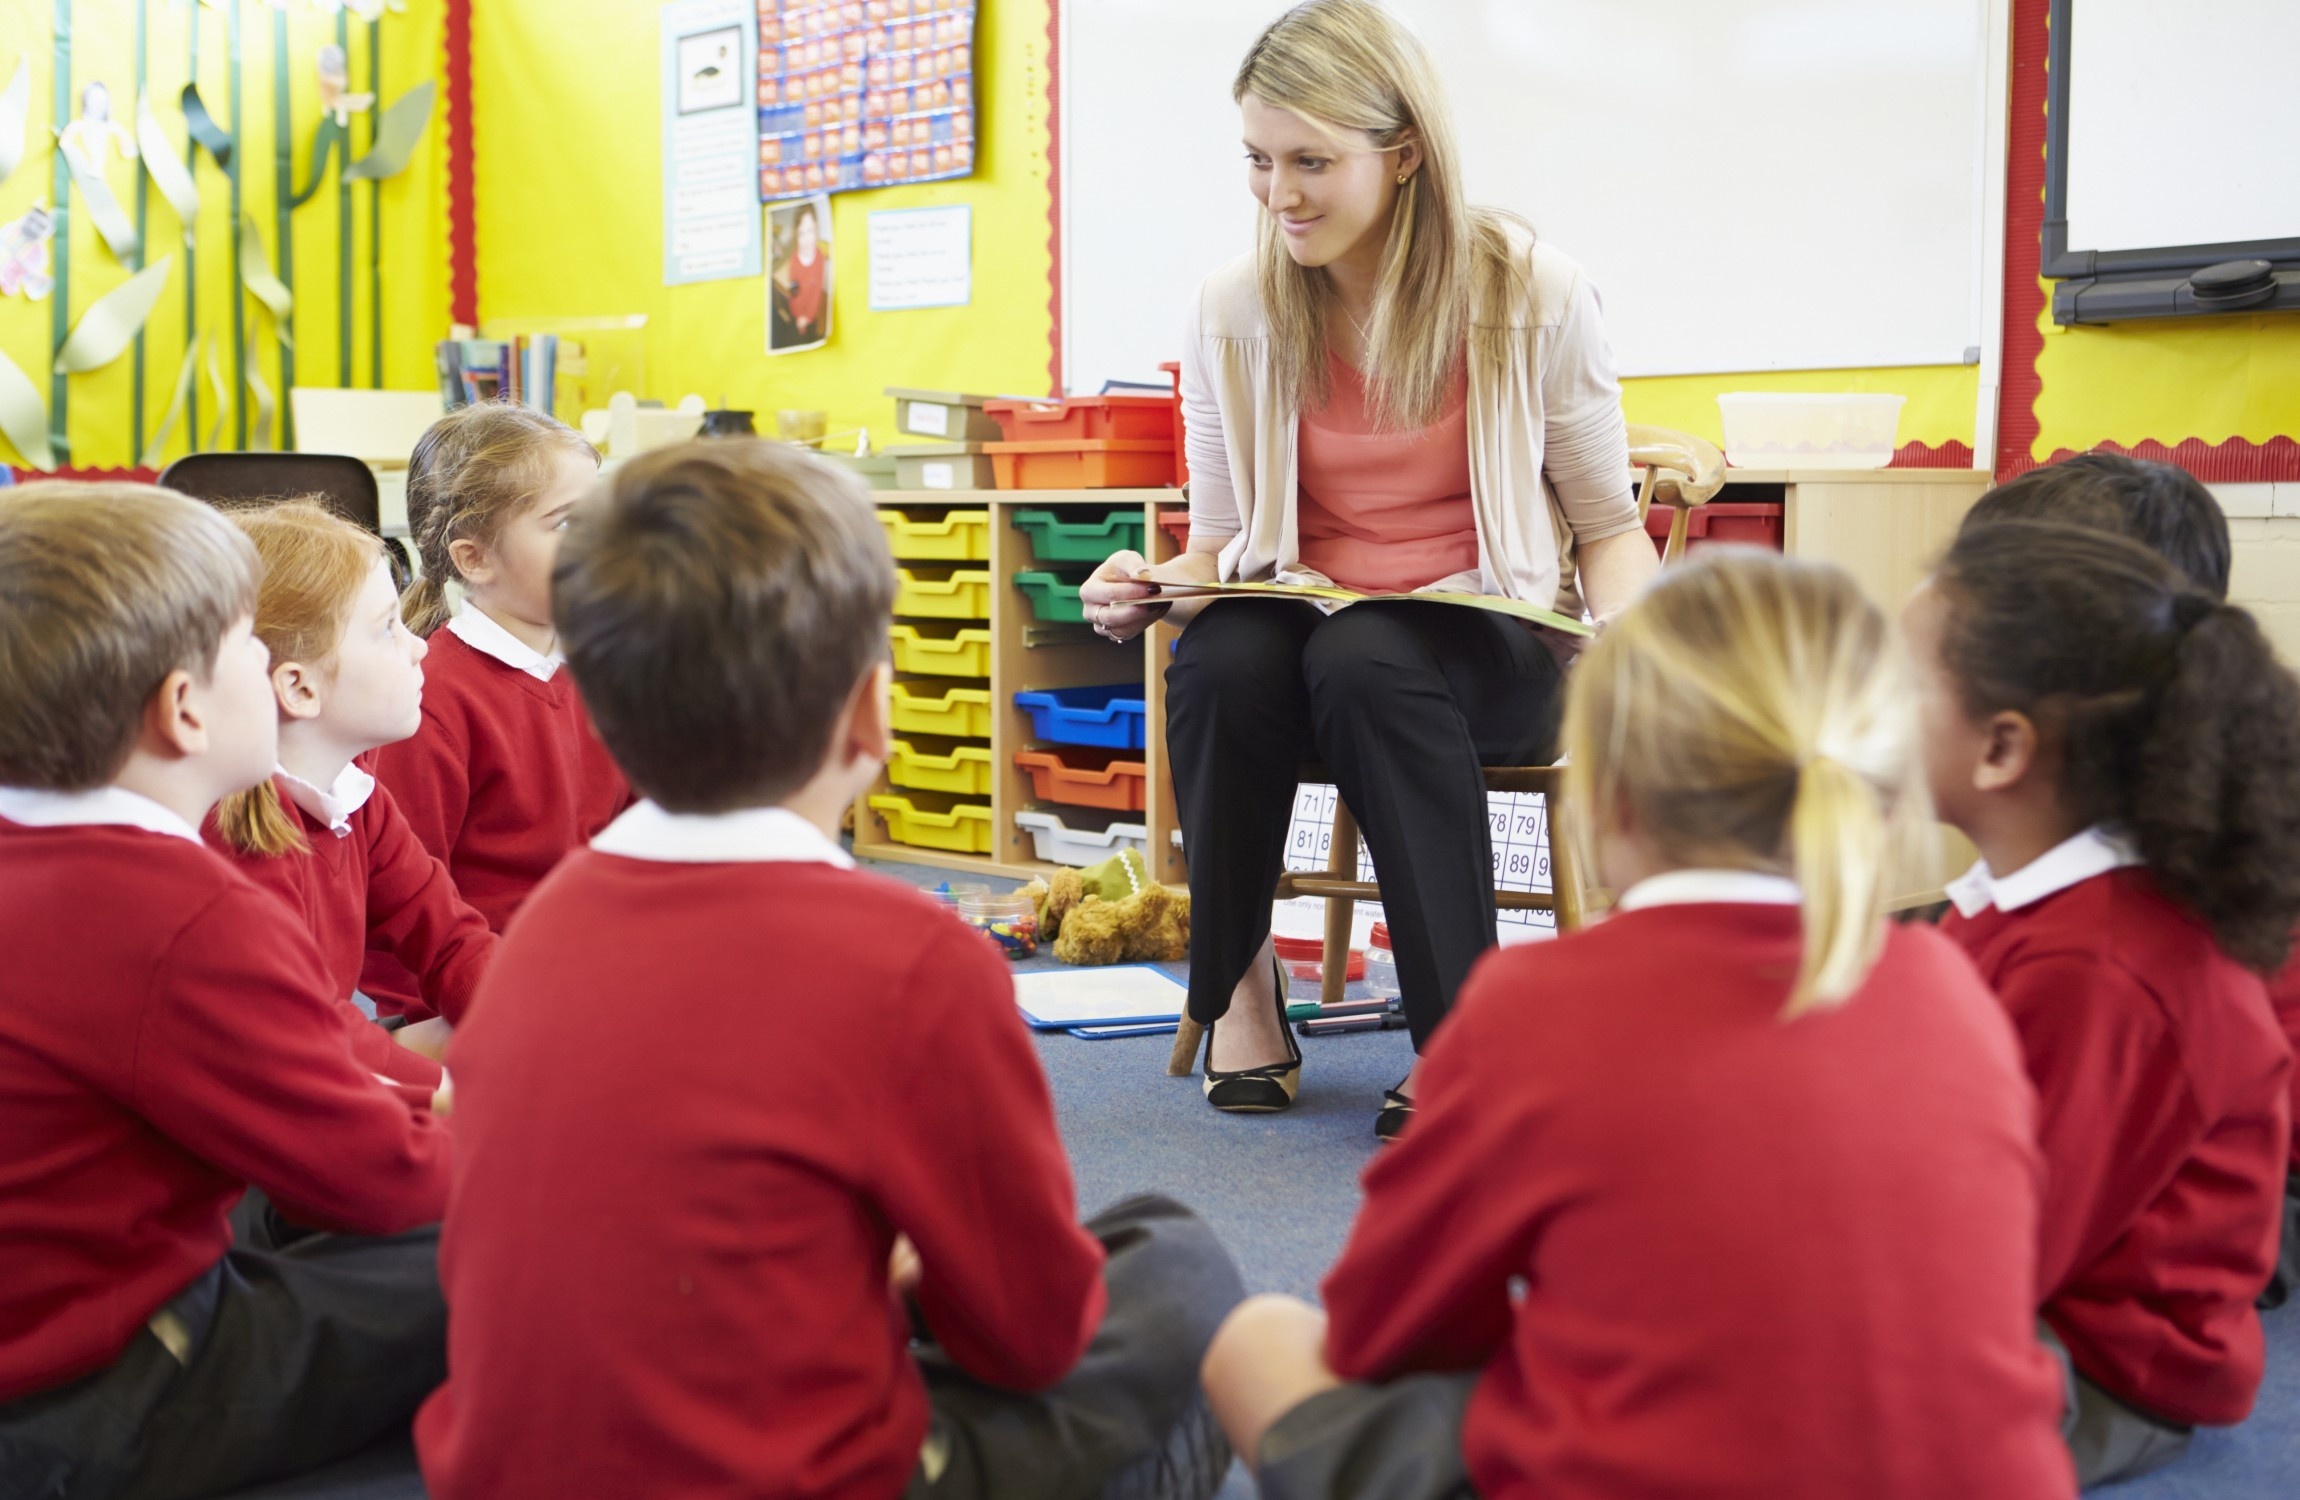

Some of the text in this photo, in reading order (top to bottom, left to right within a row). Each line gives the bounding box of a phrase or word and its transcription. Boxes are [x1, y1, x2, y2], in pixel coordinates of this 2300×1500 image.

[1304, 794, 1318, 812] 71
[1328, 796, 1336, 814] 7
[1488, 813, 1506, 832] 78
[1517, 816, 1535, 835] 79
[1297, 830, 1313, 848] 81
[1321, 832, 1330, 851] 8
[1492, 851, 1501, 871] 8
[1510, 854, 1529, 874] 89
[1538, 857, 1549, 876] 9
[1297, 901, 1312, 910] only
